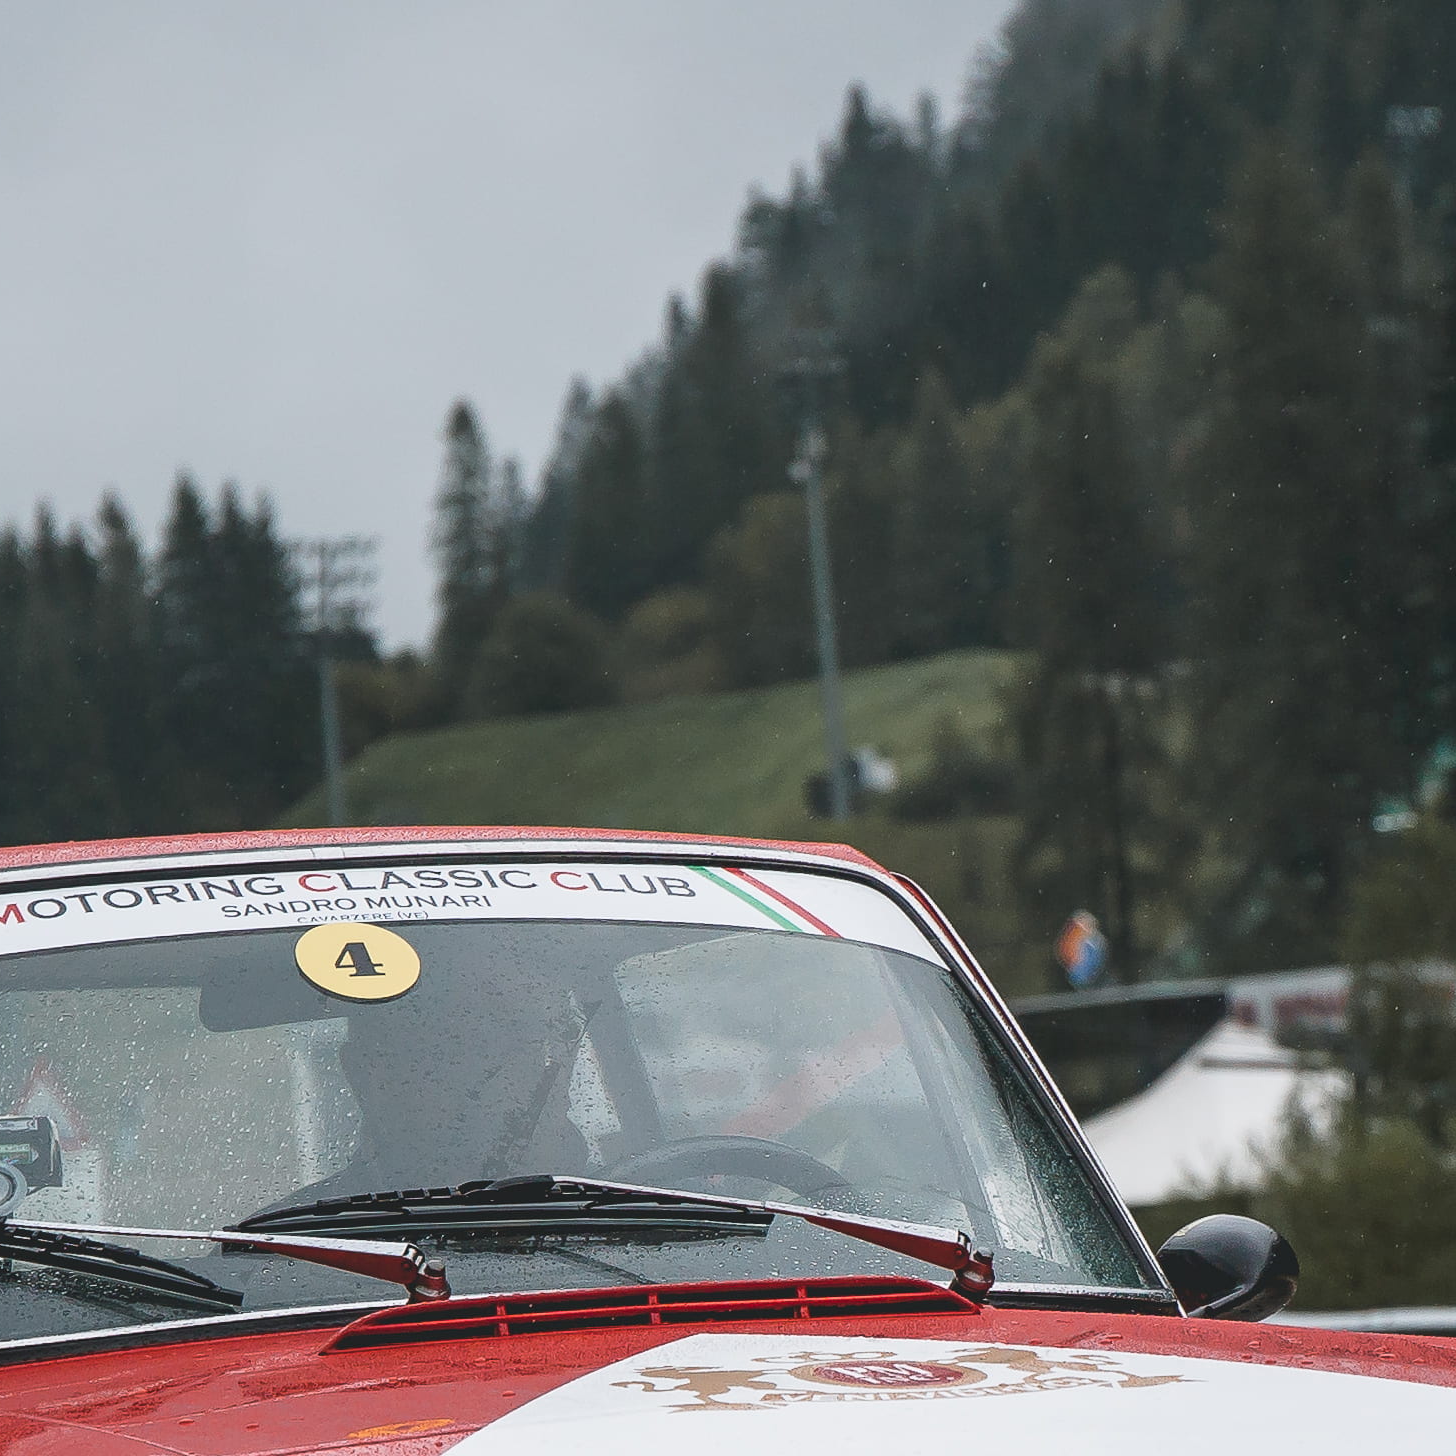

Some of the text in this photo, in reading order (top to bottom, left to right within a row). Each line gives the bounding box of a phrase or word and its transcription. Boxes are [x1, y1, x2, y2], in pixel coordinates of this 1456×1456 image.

[297, 869, 538, 893] CLASSIC
[549, 871, 698, 899] CLUB
[221, 894, 493, 919] SANDRO MUNARI
[334, 942, 386, 977] 4
